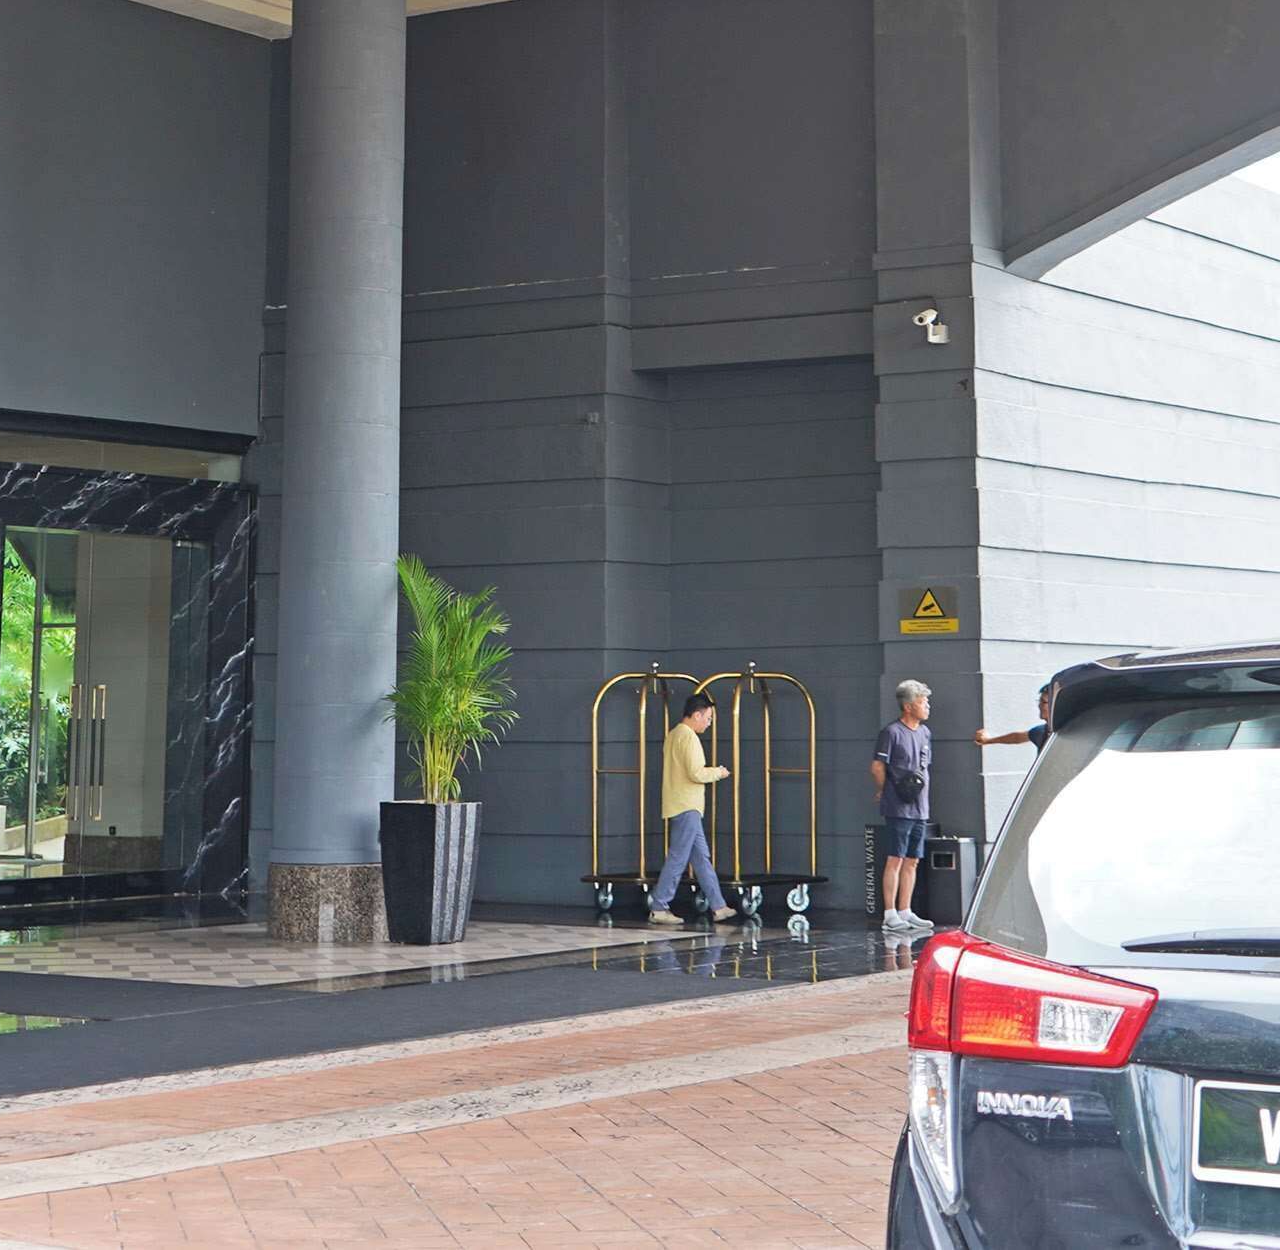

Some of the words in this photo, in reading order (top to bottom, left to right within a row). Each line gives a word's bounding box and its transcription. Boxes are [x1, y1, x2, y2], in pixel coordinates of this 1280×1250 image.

[864, 827, 875, 864] WASTE
[865, 866, 876, 914] GENERAL
[976, 1091, 1073, 1121] INNOVA
